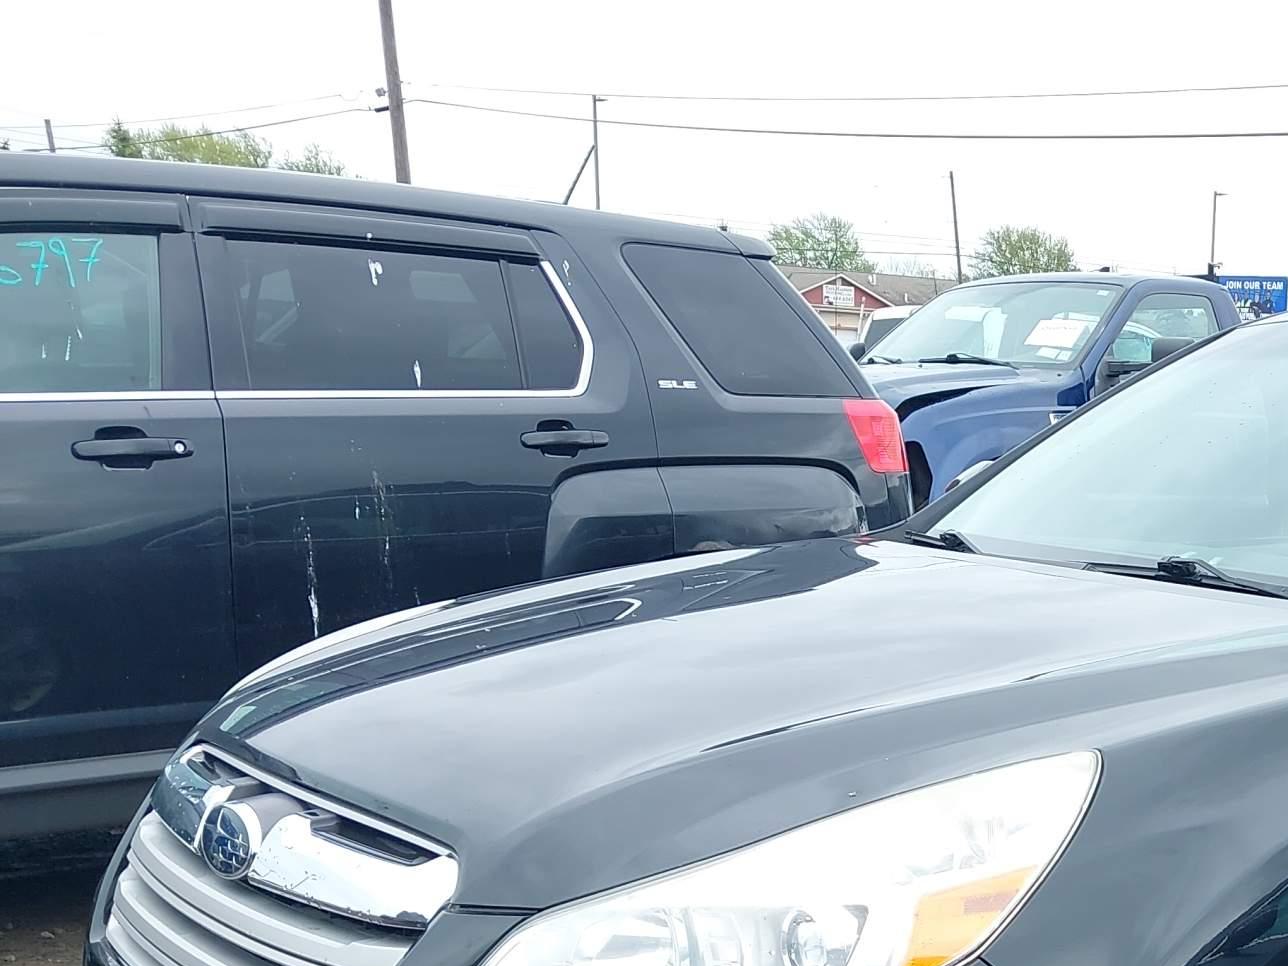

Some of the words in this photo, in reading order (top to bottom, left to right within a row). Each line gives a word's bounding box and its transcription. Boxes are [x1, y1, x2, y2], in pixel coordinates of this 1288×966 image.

[1225, 280, 1242, 290] JOIN
[1243, 280, 1260, 290] OUR
[1262, 281, 1284, 290] TEAM
[657, 379, 699, 389] SLE
